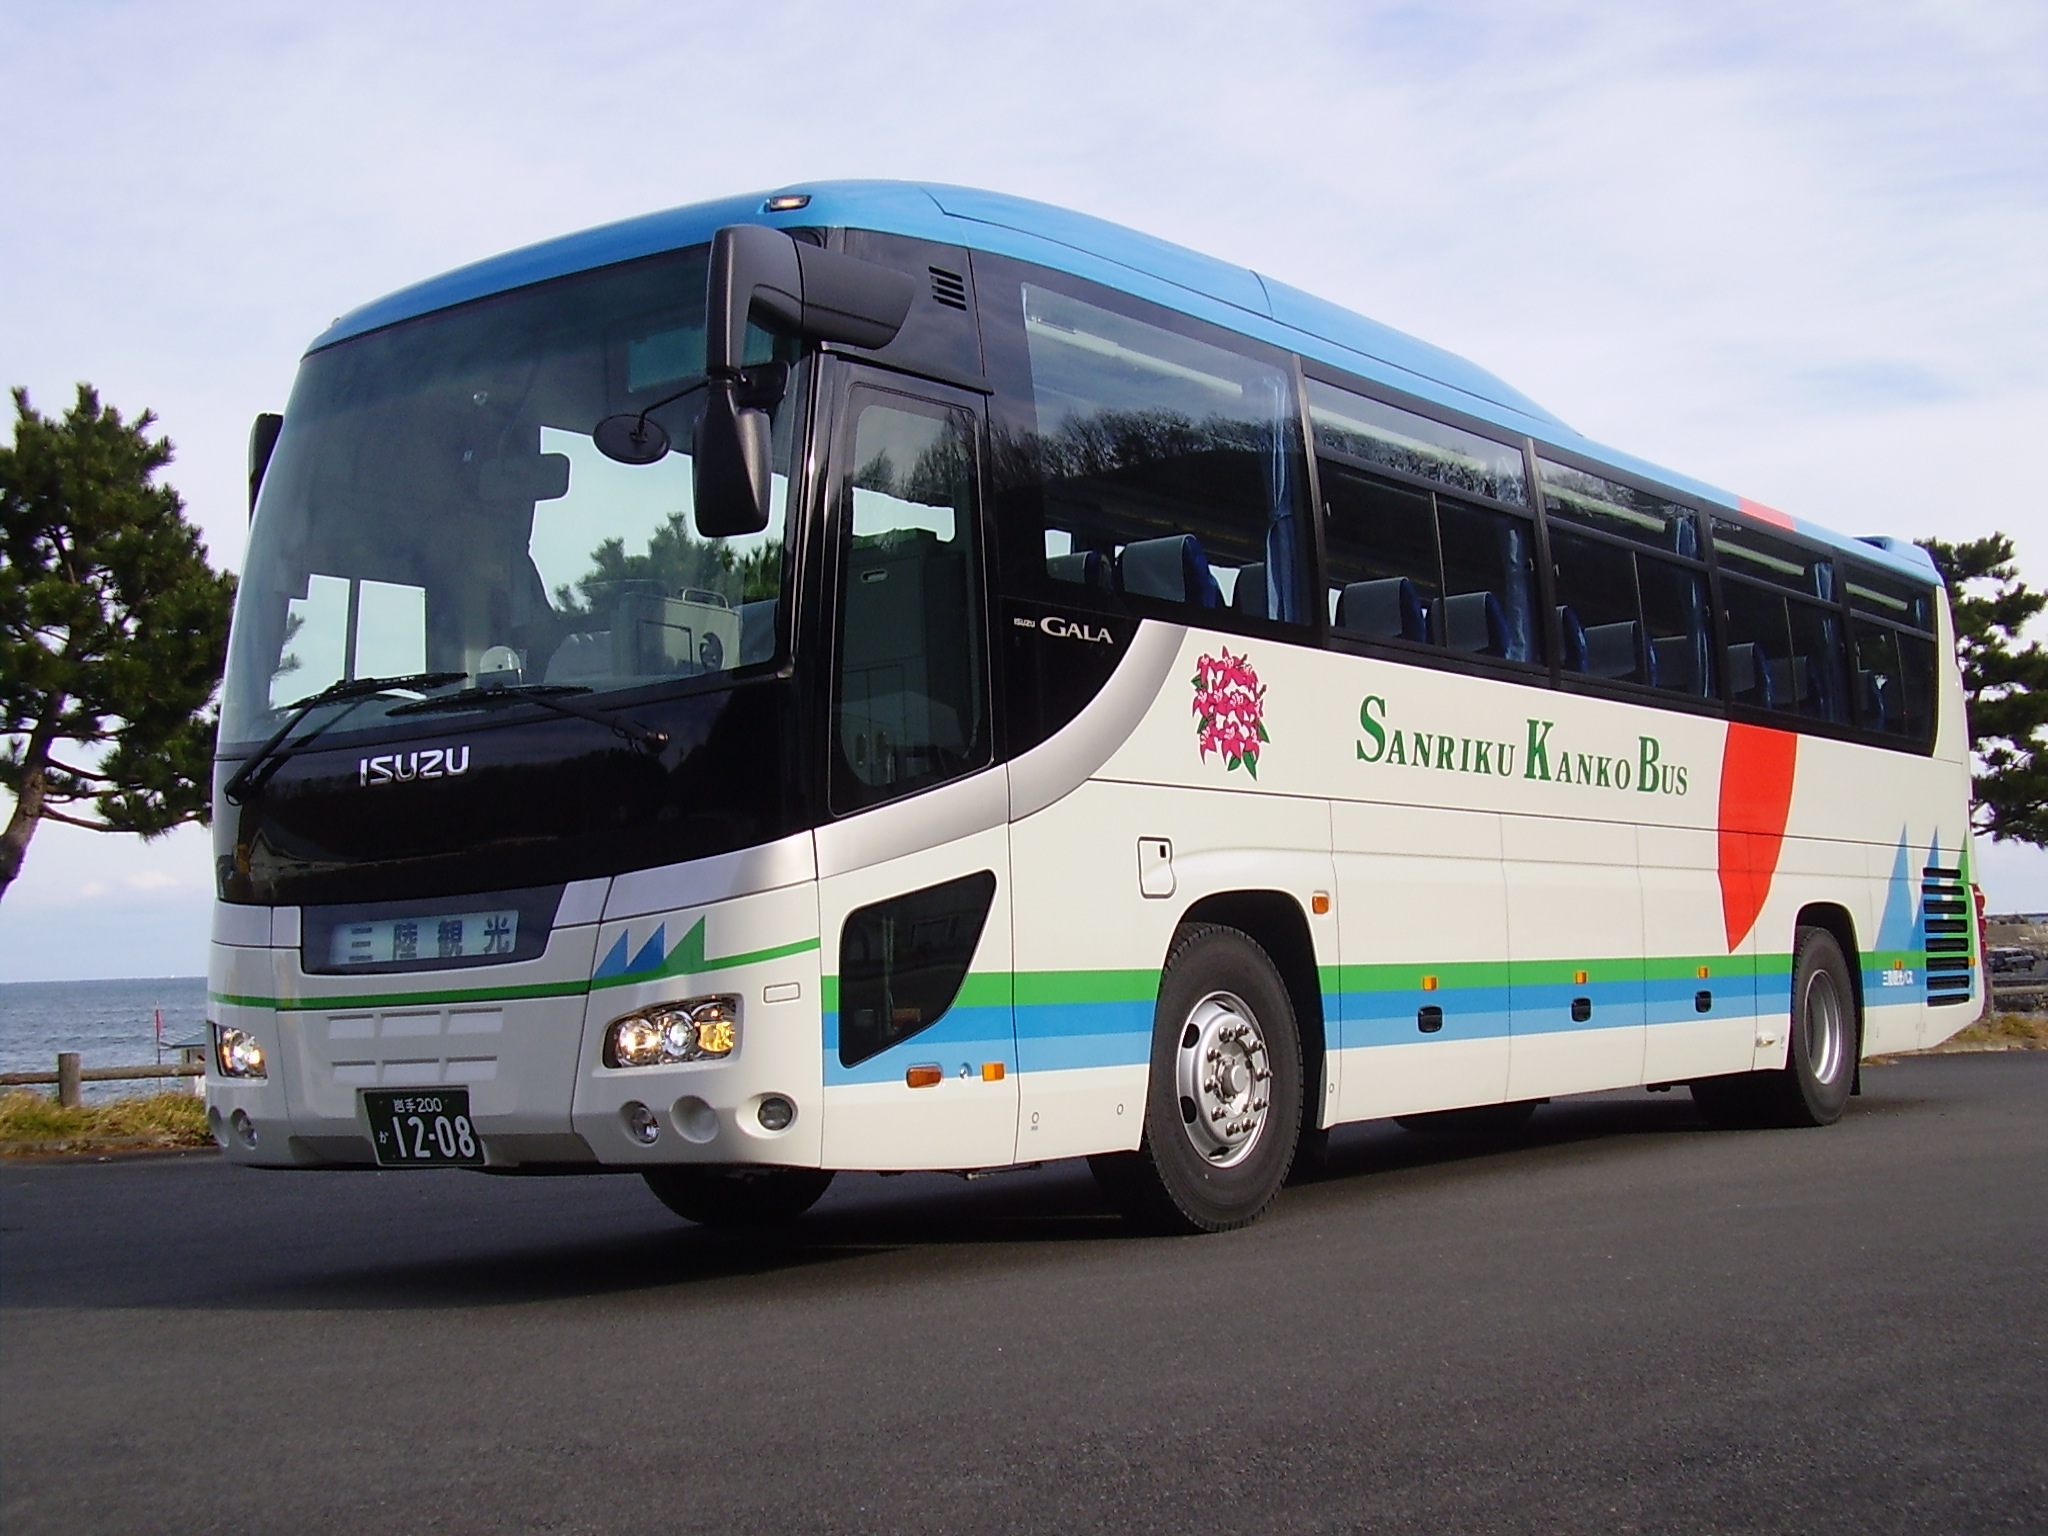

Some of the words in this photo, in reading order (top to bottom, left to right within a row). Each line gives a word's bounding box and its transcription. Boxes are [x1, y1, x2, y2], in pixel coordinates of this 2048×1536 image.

[1040, 616, 1114, 645] GALA
[360, 745, 470, 787] ISUZU
[1356, 695, 1516, 777] SANRIKU
[1524, 719, 1631, 790] KANKO
[1637, 736, 1689, 796] BUS
[349, 914, 511, 962] 三陸観光
[392, 1115, 476, 1158] 12-08
